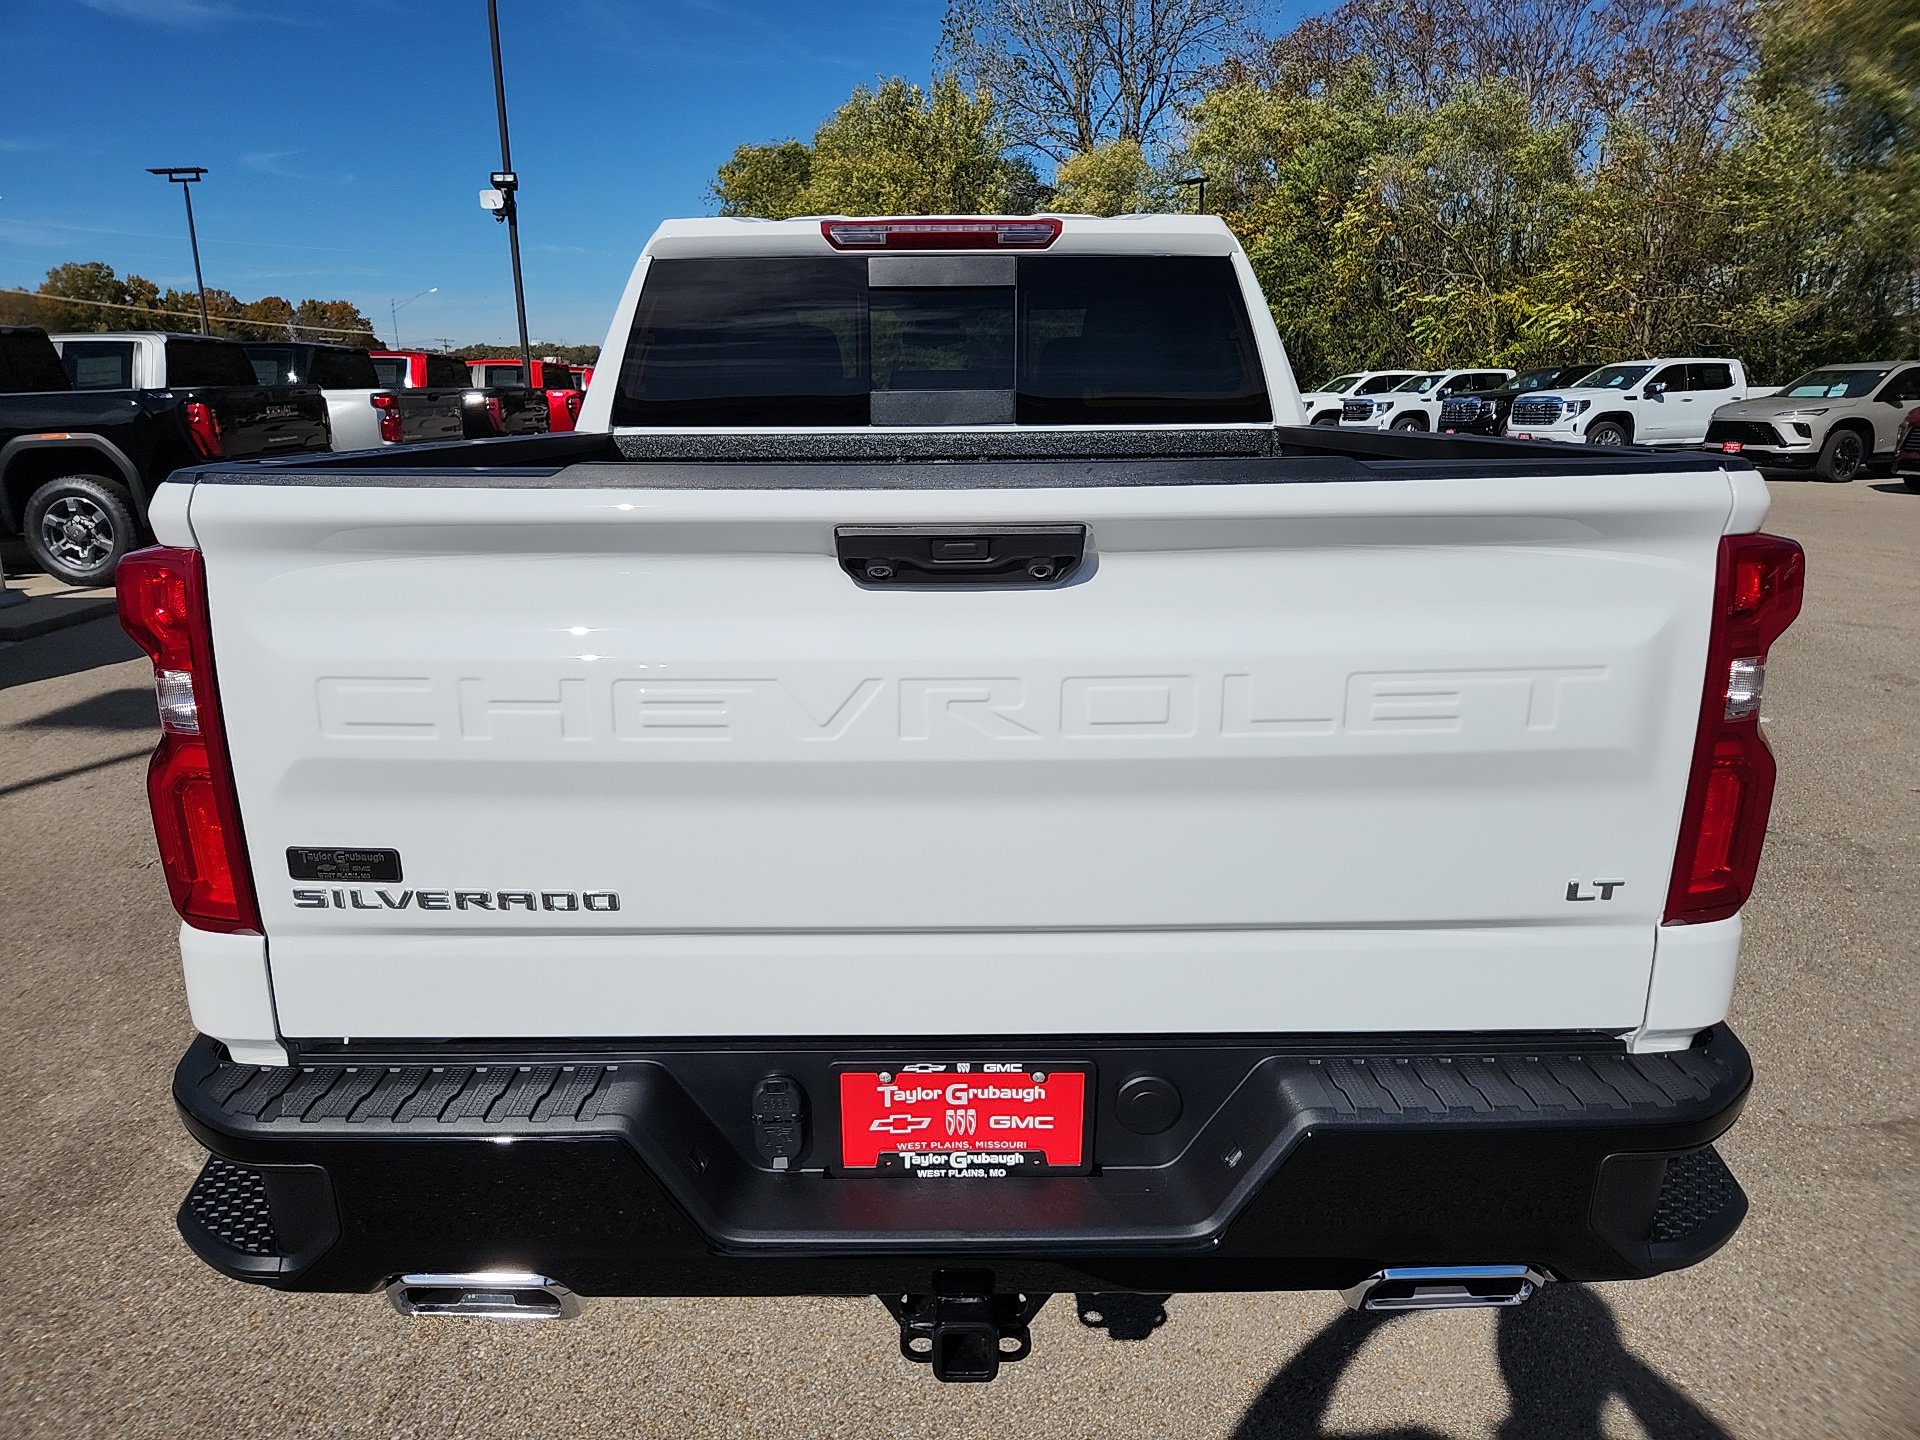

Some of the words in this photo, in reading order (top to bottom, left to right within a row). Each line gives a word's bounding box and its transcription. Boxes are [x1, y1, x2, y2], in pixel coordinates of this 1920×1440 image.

[313, 664, 1610, 742] CHEVROLET
[298, 850, 331, 863] Taylor
[333, 851, 385, 863] Grubaugh
[1565, 878, 1626, 901] LT
[292, 888, 621, 912] SILVERADO
[983, 1063, 1023, 1073] GMC
[877, 1085, 942, 1108] Taylor
[945, 1084, 1046, 1106] Grubaugh
[989, 1115, 1055, 1129] GMC
[896, 1142, 928, 1150] WEST
[930, 1141, 973, 1150] PLAINS,
[976, 1141, 1027, 1149] MISSOURI
[899, 1152, 949, 1169] Taylor
[949, 1151, 1025, 1168] Grubaugh
[917, 1169, 947, 1178] WEST
[948, 1169, 987, 1179] PLAINS,
[989, 1169, 1006, 1178] MO
